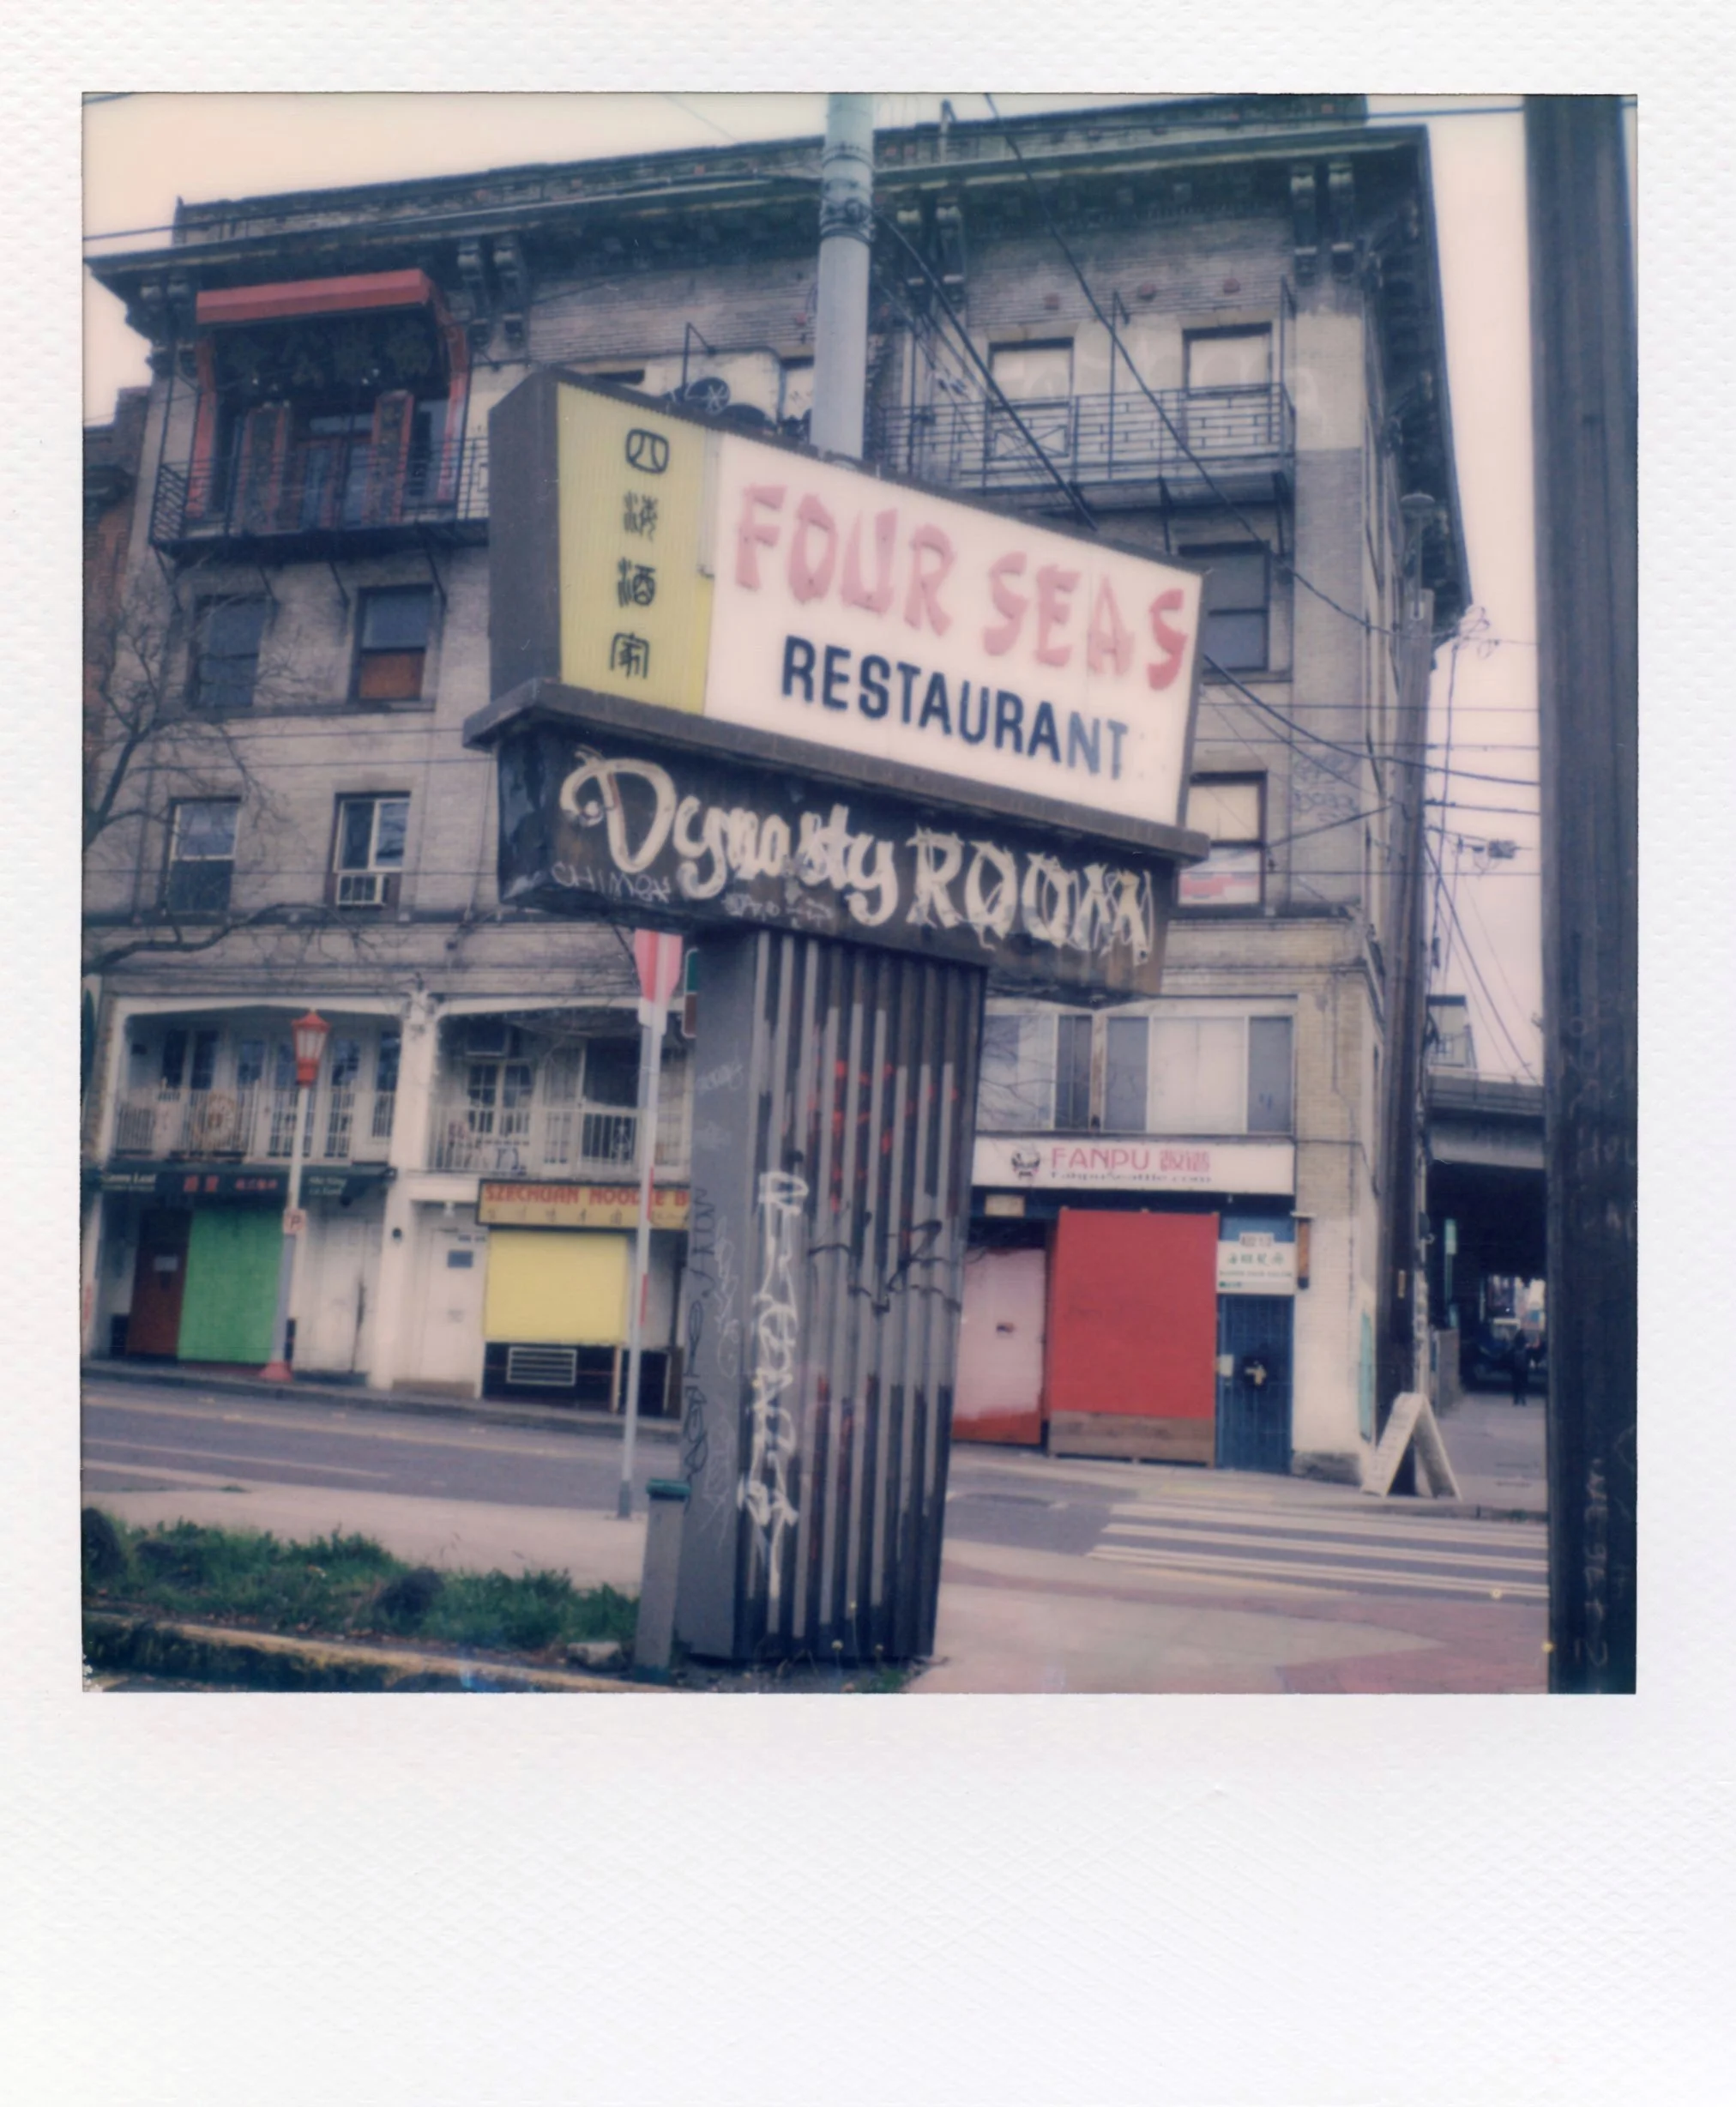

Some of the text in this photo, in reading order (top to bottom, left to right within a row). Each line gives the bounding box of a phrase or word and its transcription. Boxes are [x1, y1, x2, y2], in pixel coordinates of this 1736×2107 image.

[735, 483, 1188, 691] FOUR SEAS
[781, 635, 1129, 781] RESTAURANT
[558, 745, 899, 927] Dynasty
[1051, 1147, 1150, 1171] FANPU
